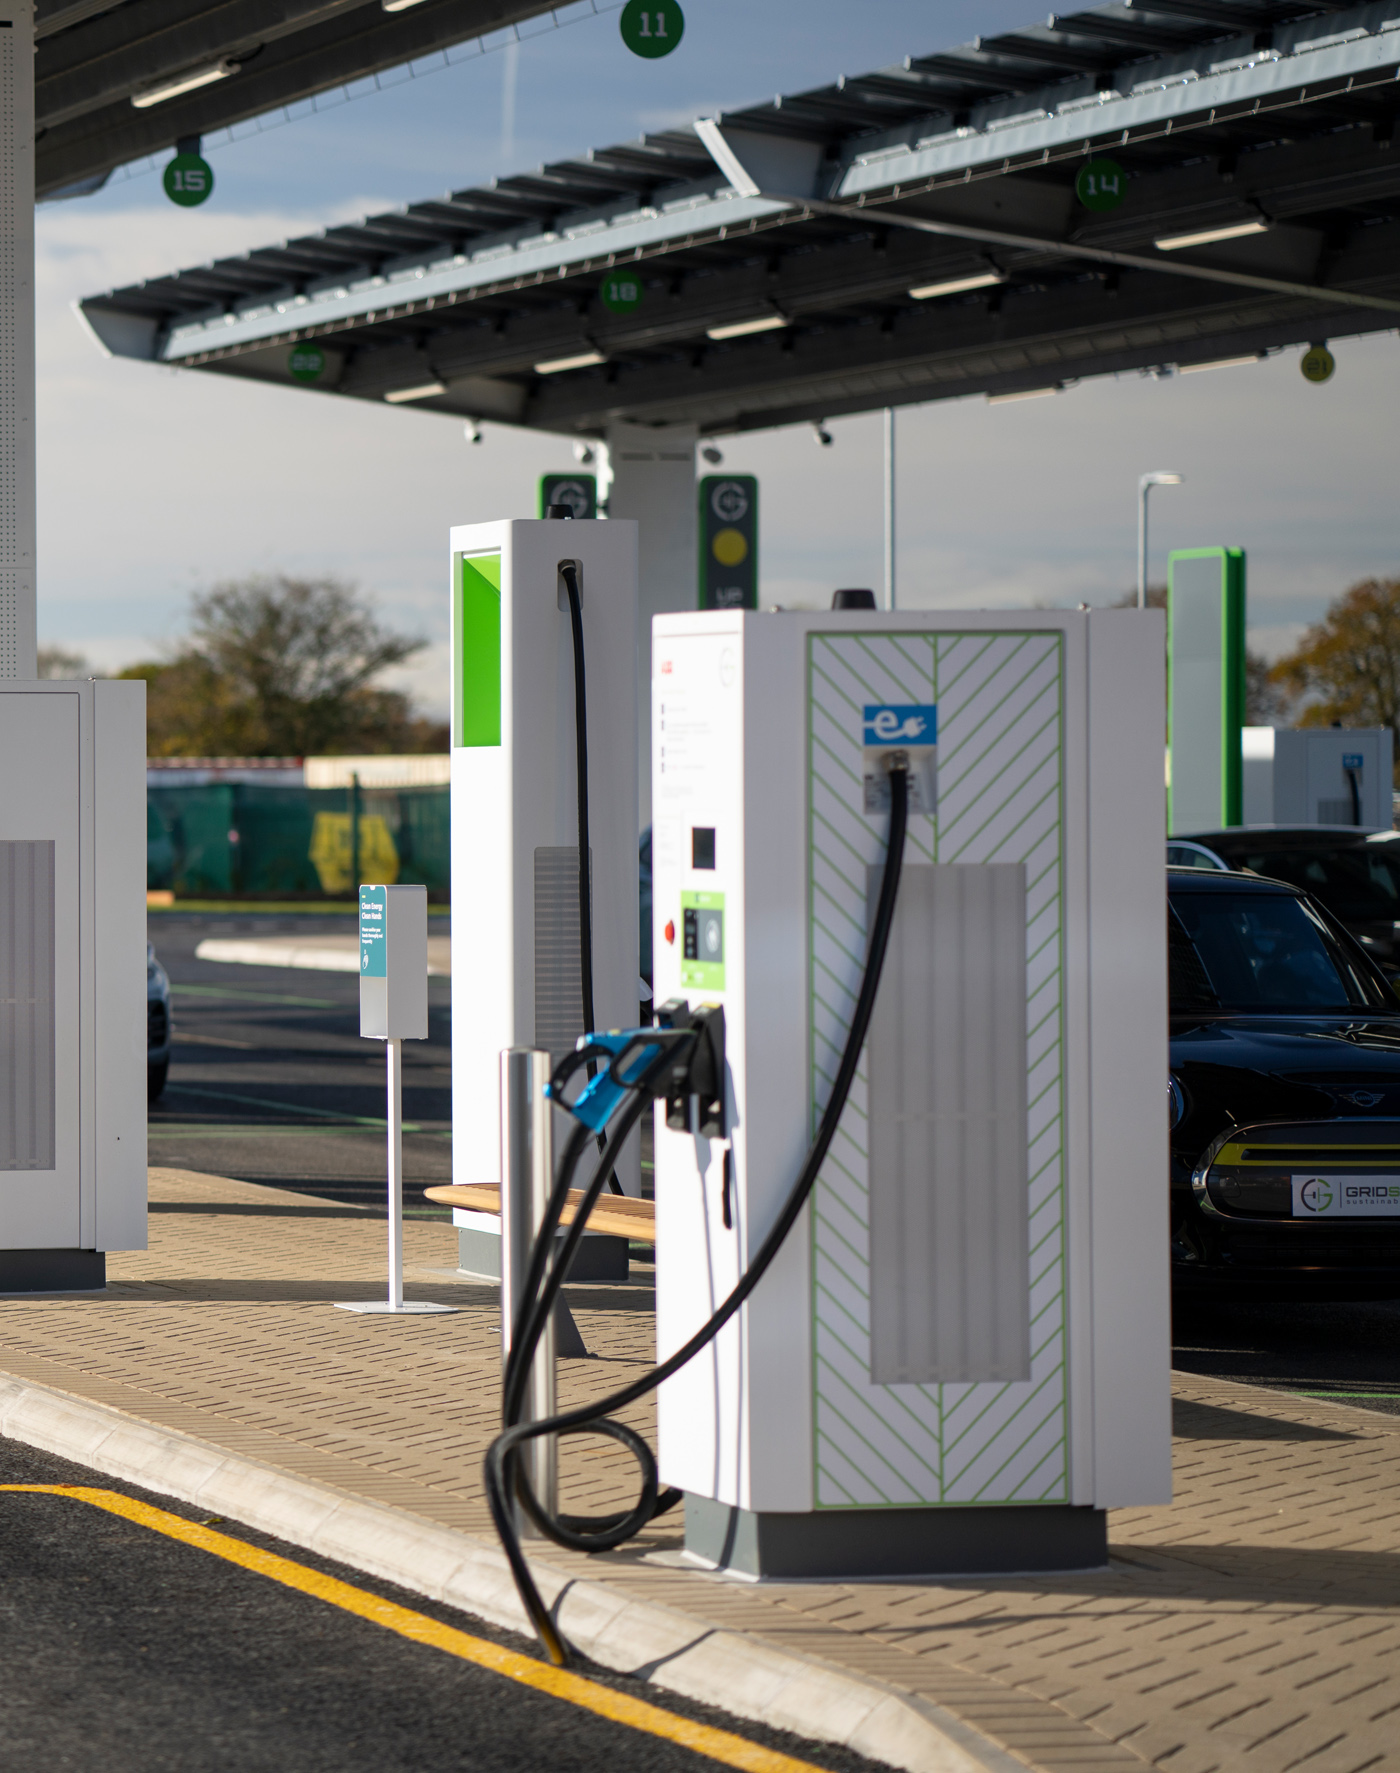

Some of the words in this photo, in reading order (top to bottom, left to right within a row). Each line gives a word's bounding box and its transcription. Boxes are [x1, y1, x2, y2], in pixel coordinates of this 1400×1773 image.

[639, 11, 668, 37] 11
[173, 170, 206, 191] 15
[1087, 174, 1119, 195] 14
